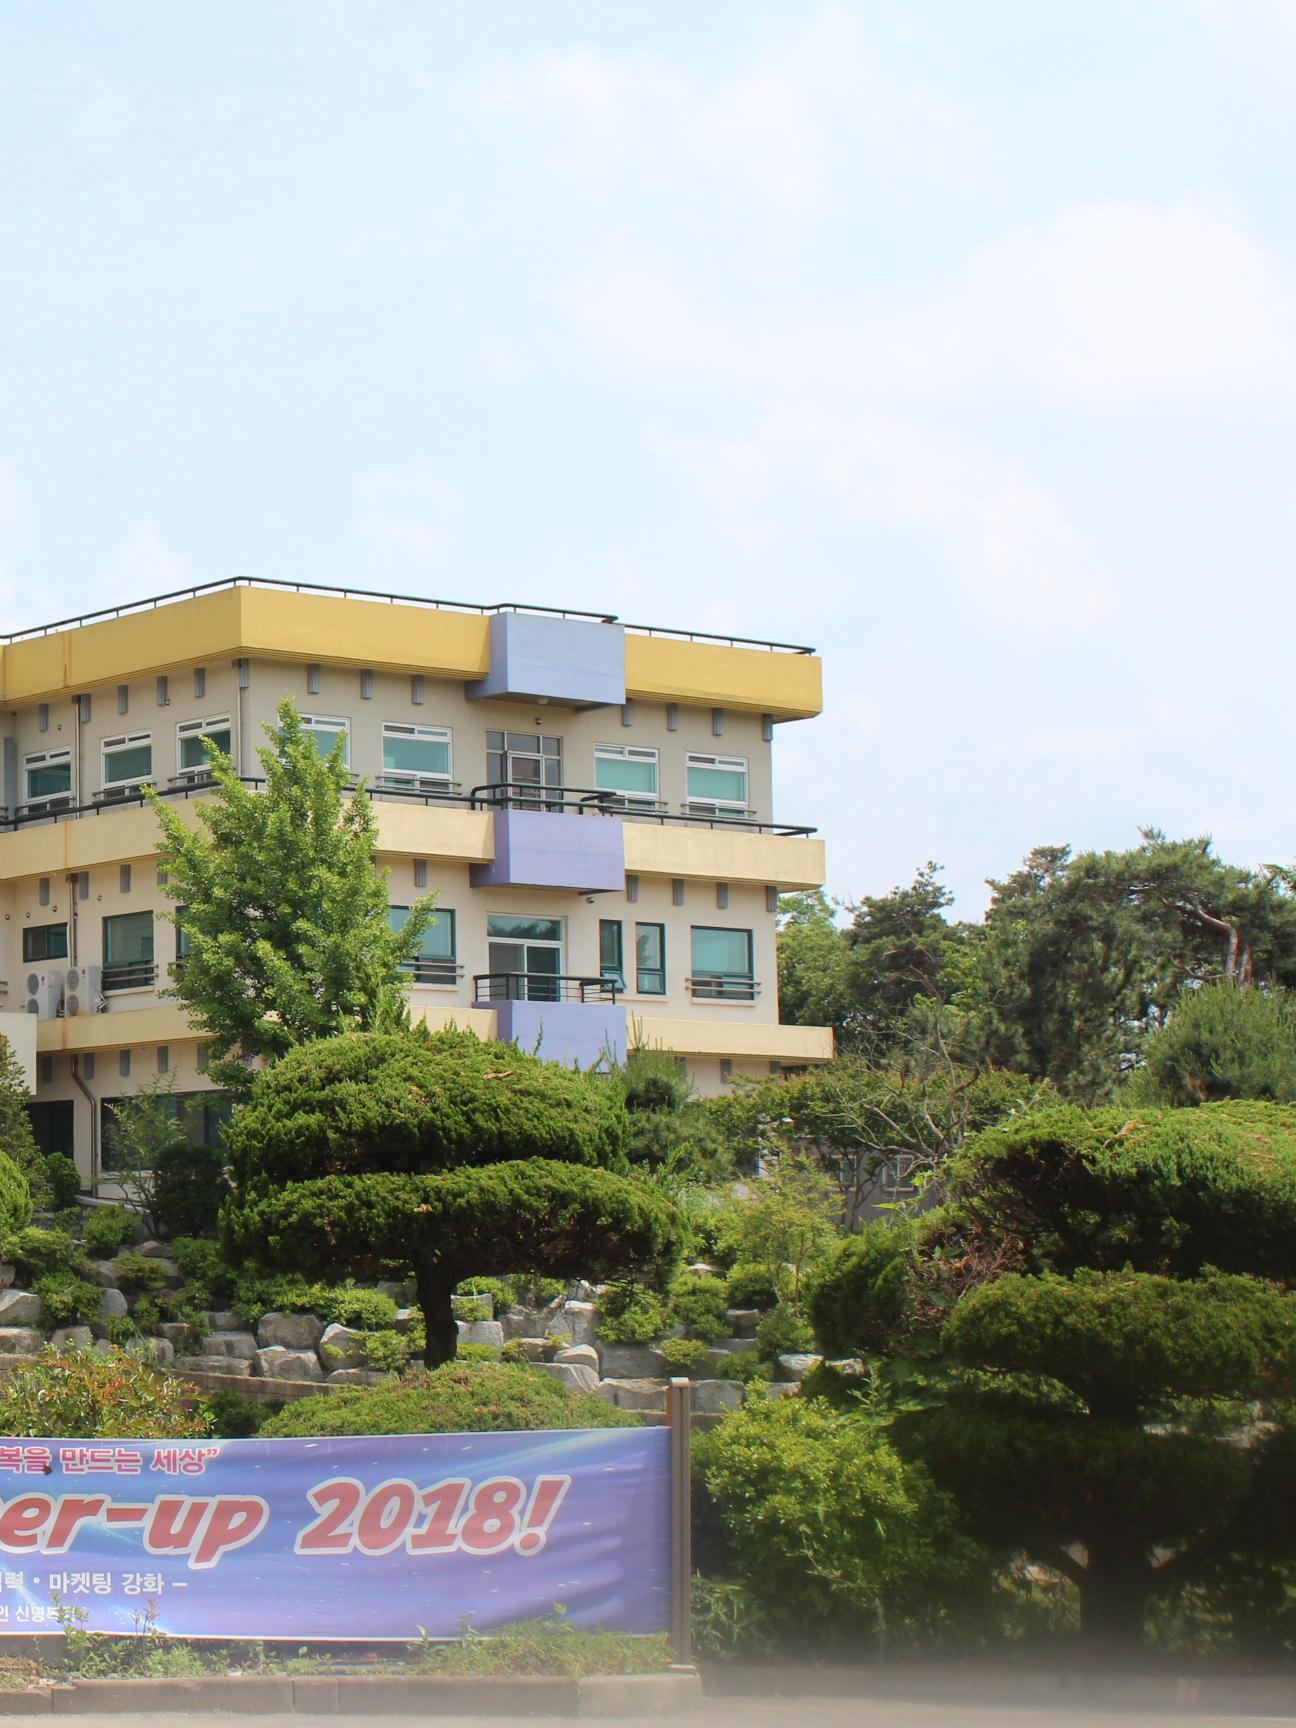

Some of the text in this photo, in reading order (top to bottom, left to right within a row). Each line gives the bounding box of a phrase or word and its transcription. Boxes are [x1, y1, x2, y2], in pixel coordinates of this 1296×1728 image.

[60, 1447, 142, 1474] 만드는
[294, 1475, 572, 1556] 2018!
[49, 1572, 112, 1595] 마켓팅
[122, 1573, 164, 1595] 강화
